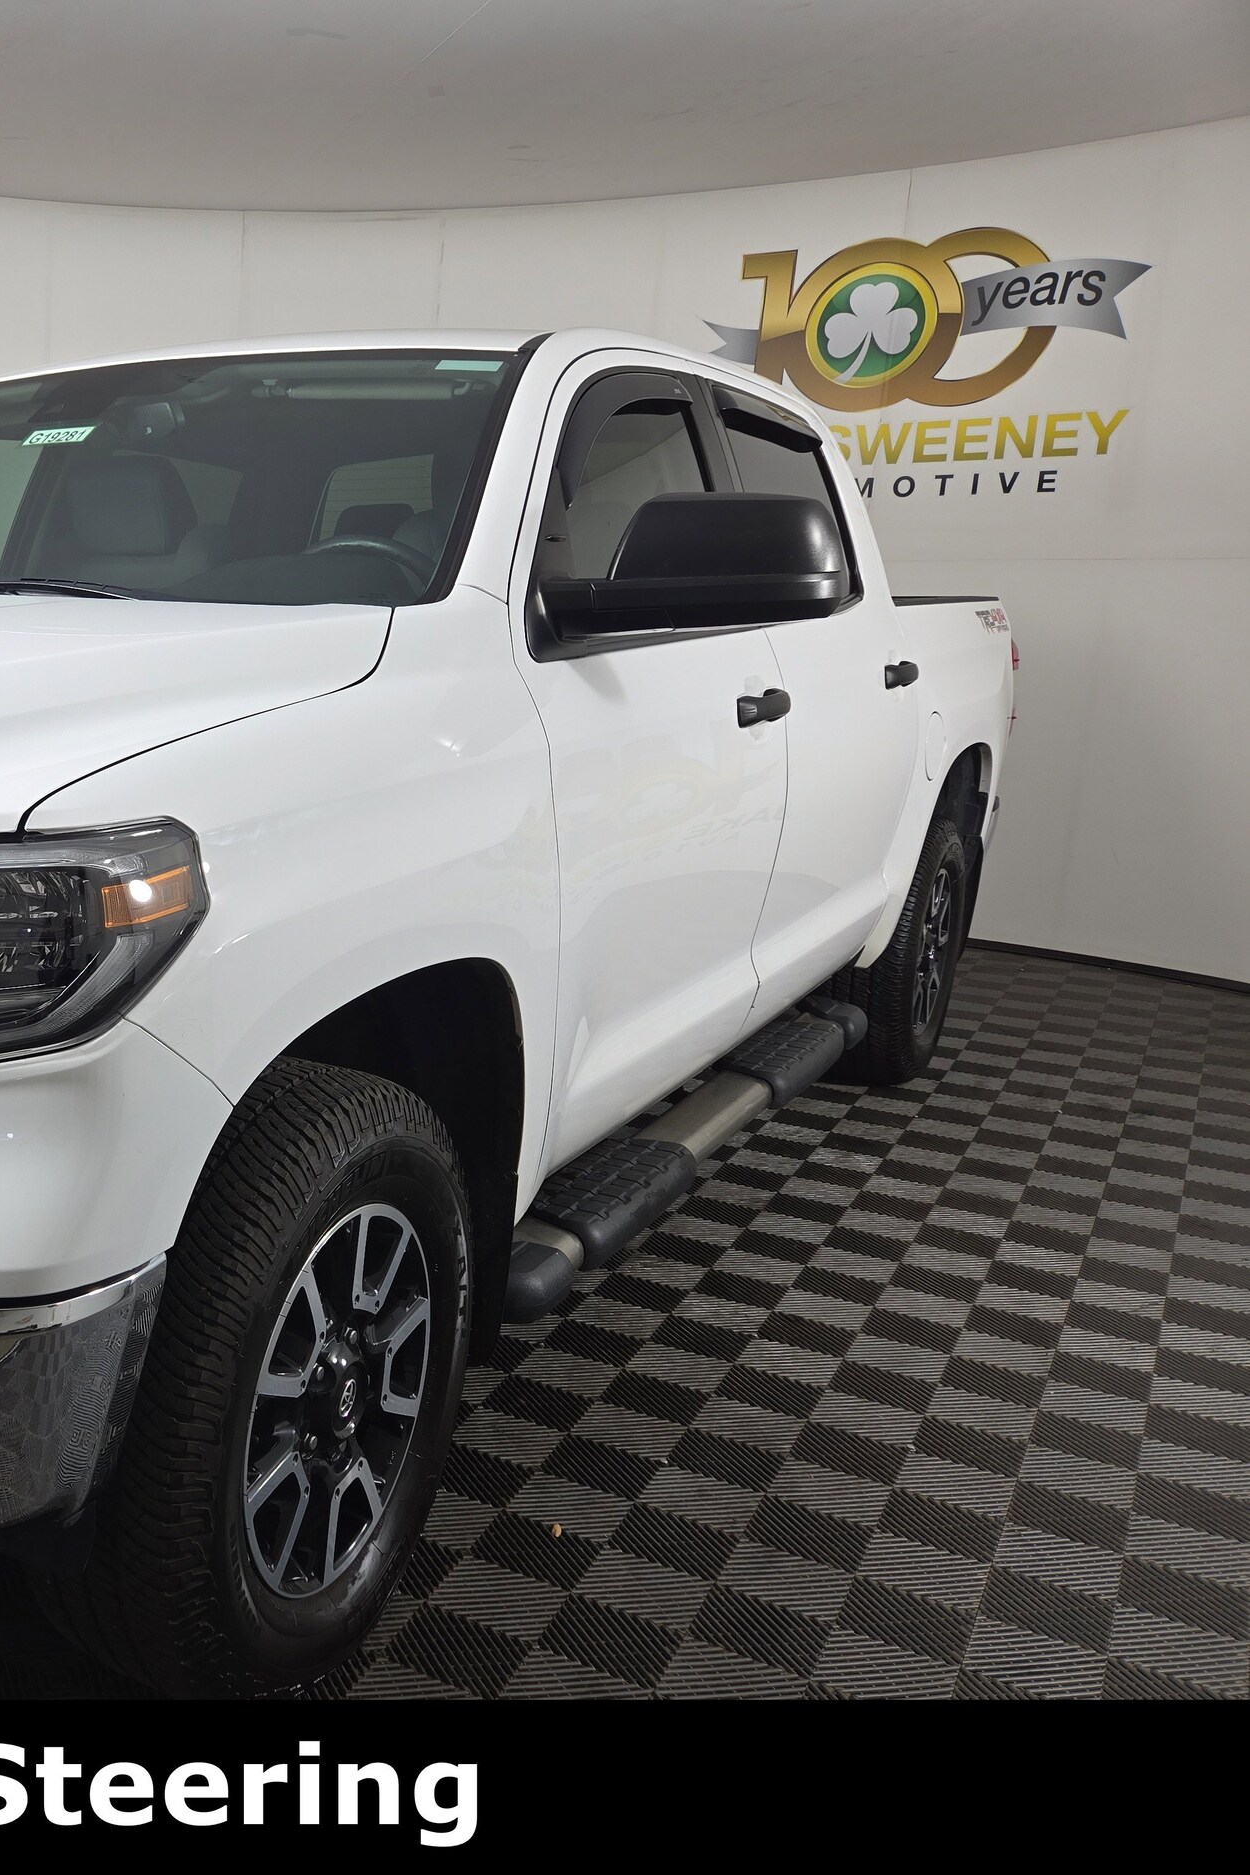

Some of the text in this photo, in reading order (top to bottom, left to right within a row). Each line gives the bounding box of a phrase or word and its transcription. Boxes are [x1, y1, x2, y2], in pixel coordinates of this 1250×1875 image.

[972, 269, 1106, 326] years
[28, 429, 88, 444] G19281
[829, 409, 1130, 466] SWEENEY
